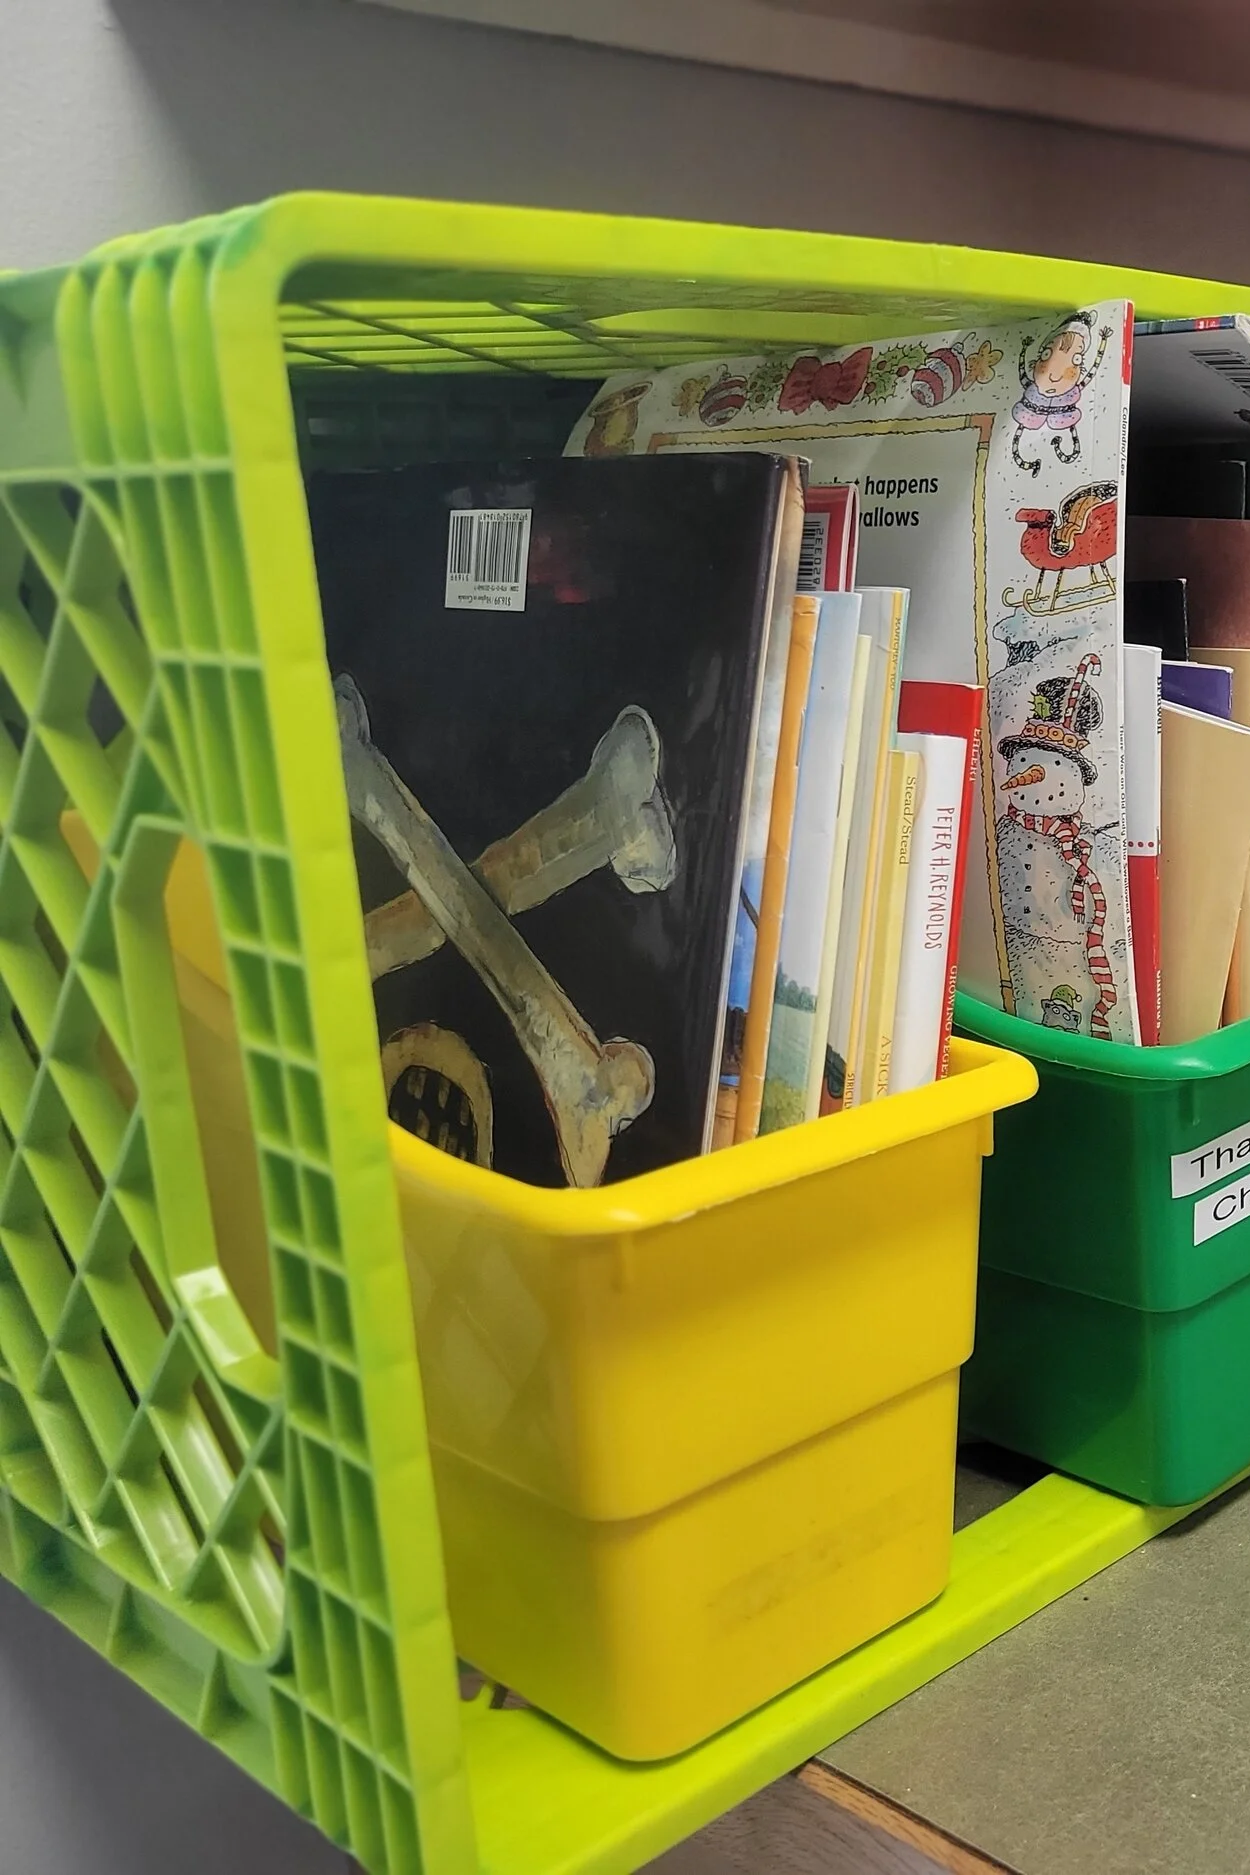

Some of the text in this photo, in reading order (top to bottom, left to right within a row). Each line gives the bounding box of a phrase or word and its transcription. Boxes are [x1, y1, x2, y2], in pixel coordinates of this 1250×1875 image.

[859, 507, 920, 527] allows
[864, 476, 938, 498] happens
[899, 775, 916, 866] Stead/Stead
[931, 807, 955, 851] PETER
[924, 874, 949, 950] REYNOLDS
[941, 965, 957, 1080] GROWING VEGET
[877, 1035, 892, 1095] A SICK
